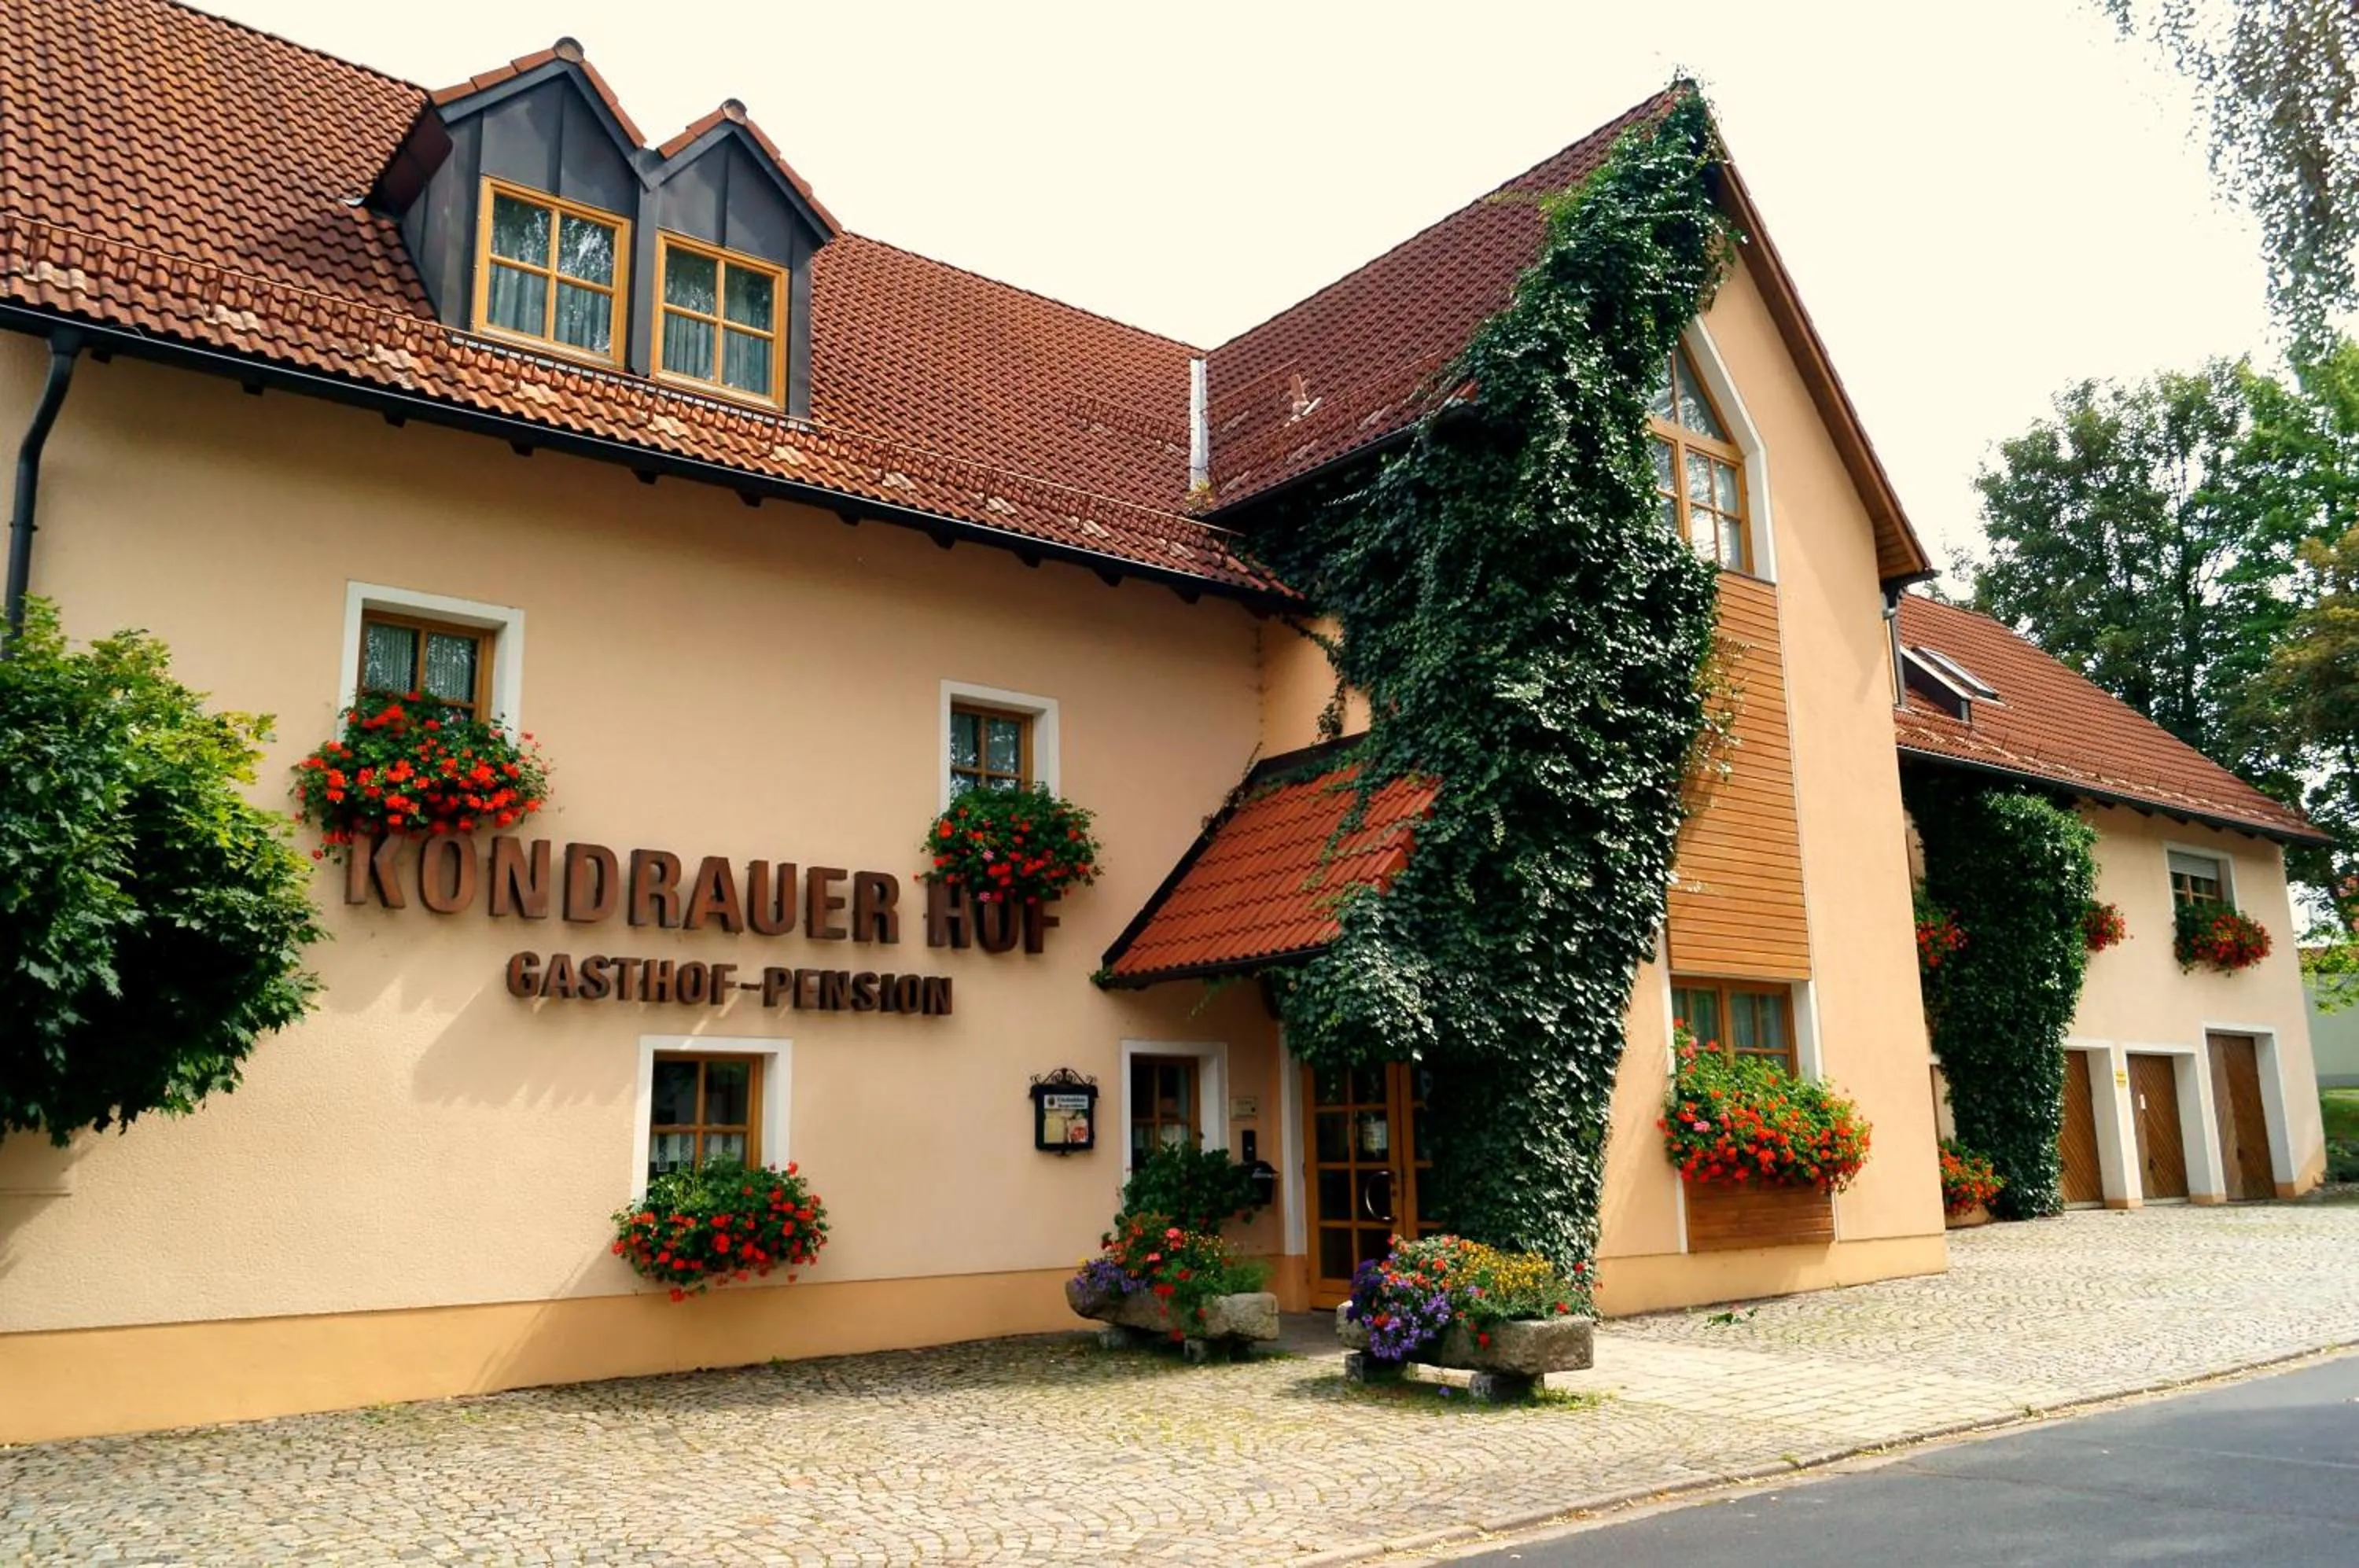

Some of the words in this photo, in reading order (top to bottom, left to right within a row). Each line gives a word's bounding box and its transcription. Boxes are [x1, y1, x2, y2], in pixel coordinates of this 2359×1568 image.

[344, 832, 900, 944] KONDRAUER
[927, 878, 1061, 954] HOF
[506, 951, 953, 1015] GASTHOF-PENSION
